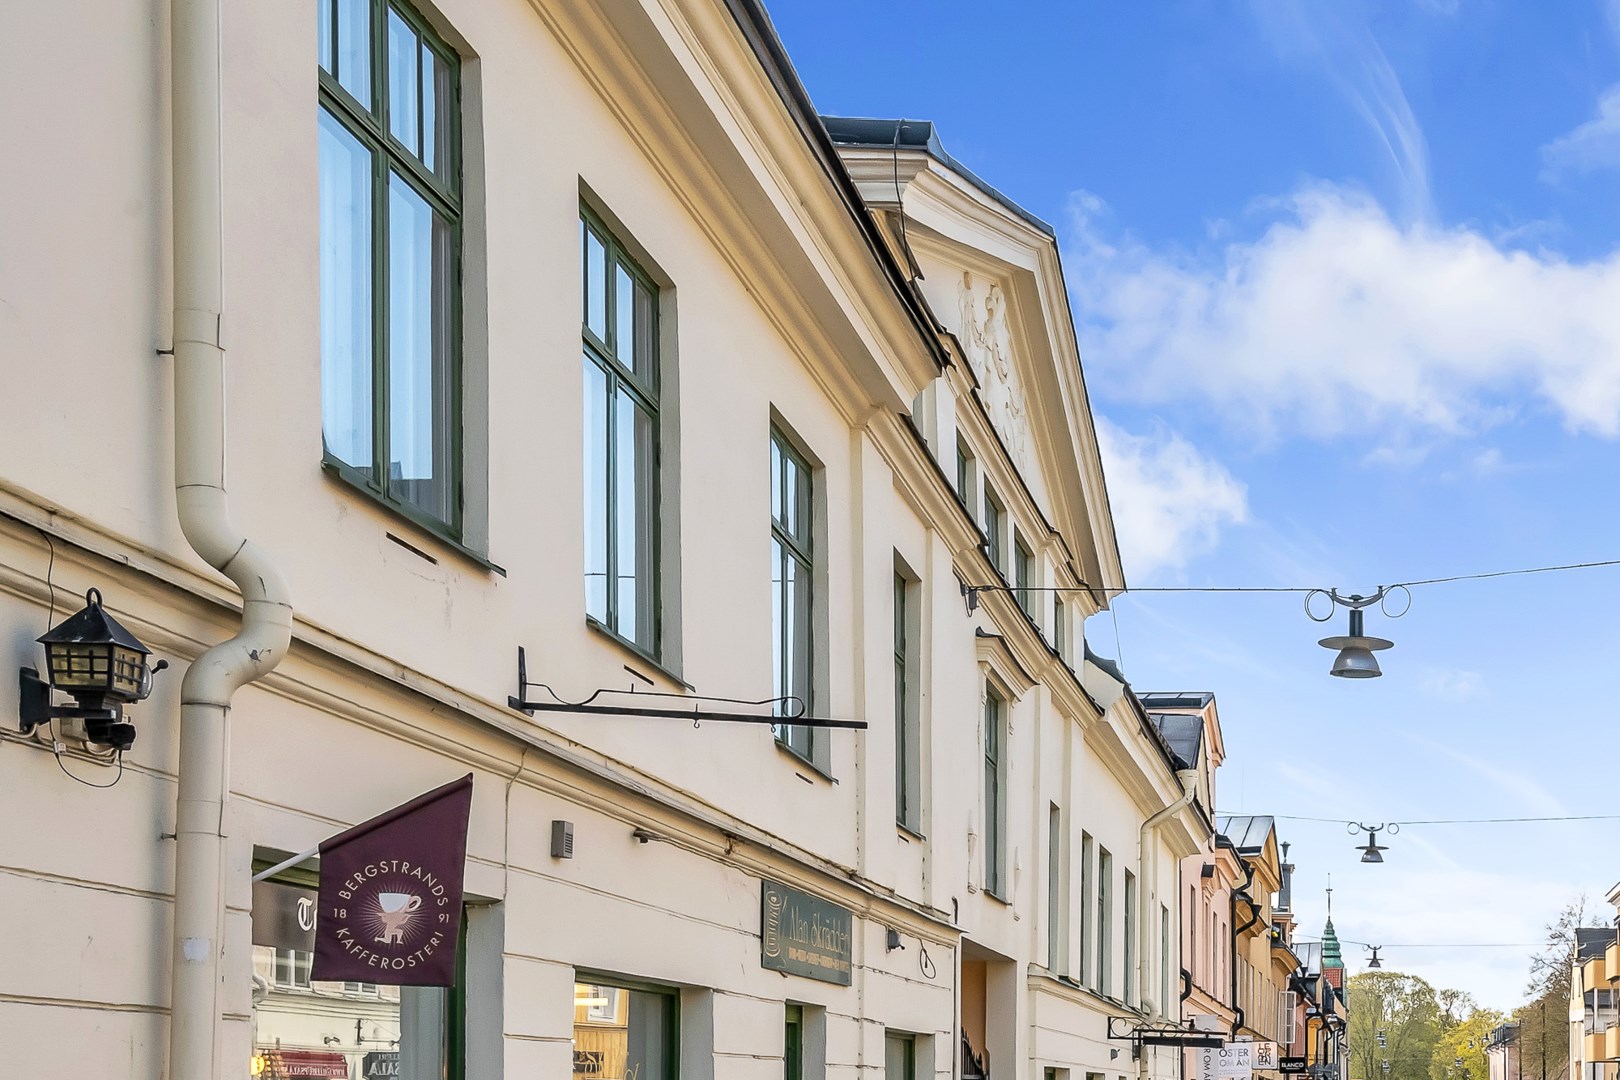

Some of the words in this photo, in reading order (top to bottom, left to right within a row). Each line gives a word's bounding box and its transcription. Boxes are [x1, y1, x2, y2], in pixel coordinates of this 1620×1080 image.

[338, 860, 449, 906] BERGSTRANDS
[333, 908, 347, 919] 18
[438, 913, 450, 923] 91
[336, 927, 444, 970] KAFFEROSTERI
